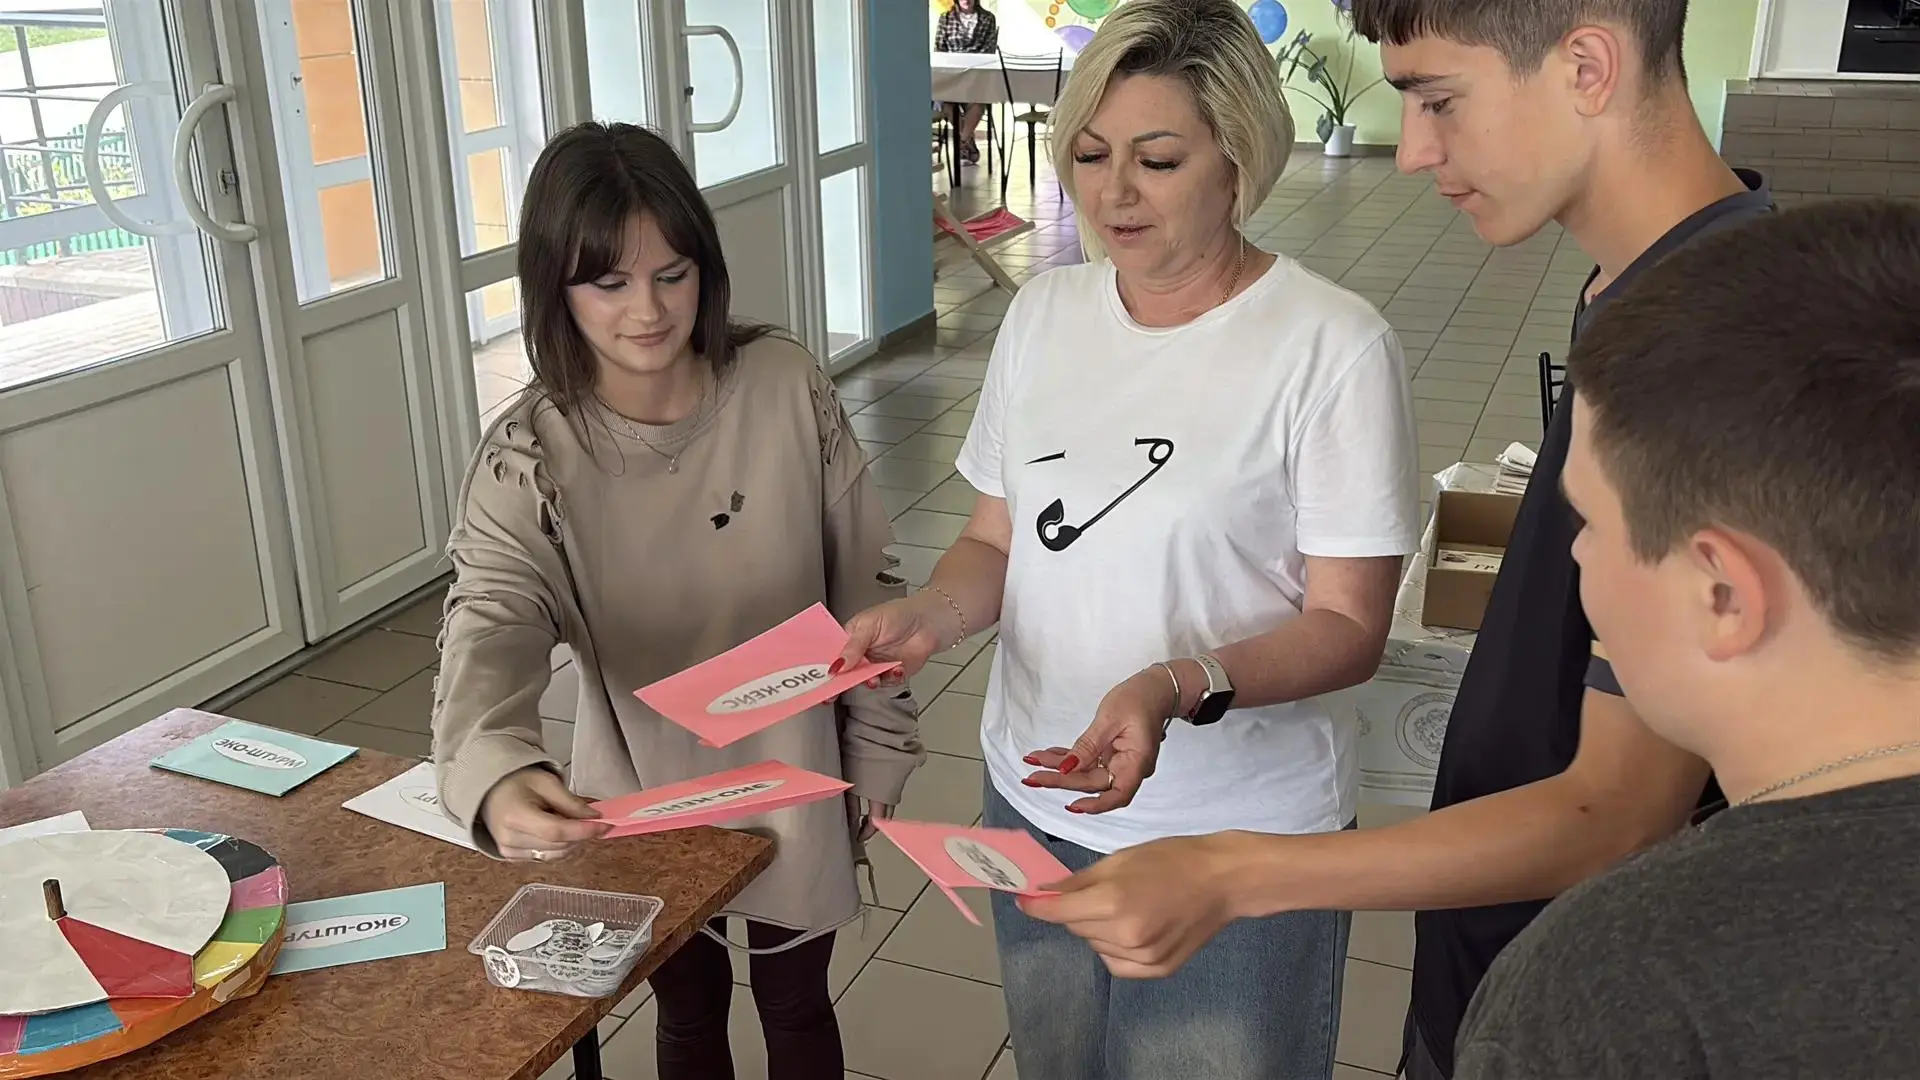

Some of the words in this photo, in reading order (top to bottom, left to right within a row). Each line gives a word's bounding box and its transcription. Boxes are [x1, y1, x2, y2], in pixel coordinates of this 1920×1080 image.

[722, 668, 825, 709] ЭКО-КЕЙС
[215, 738, 305, 768] ЭКО-ШТУРМ
[283, 916, 403, 943] ЭКО-ШТУР
